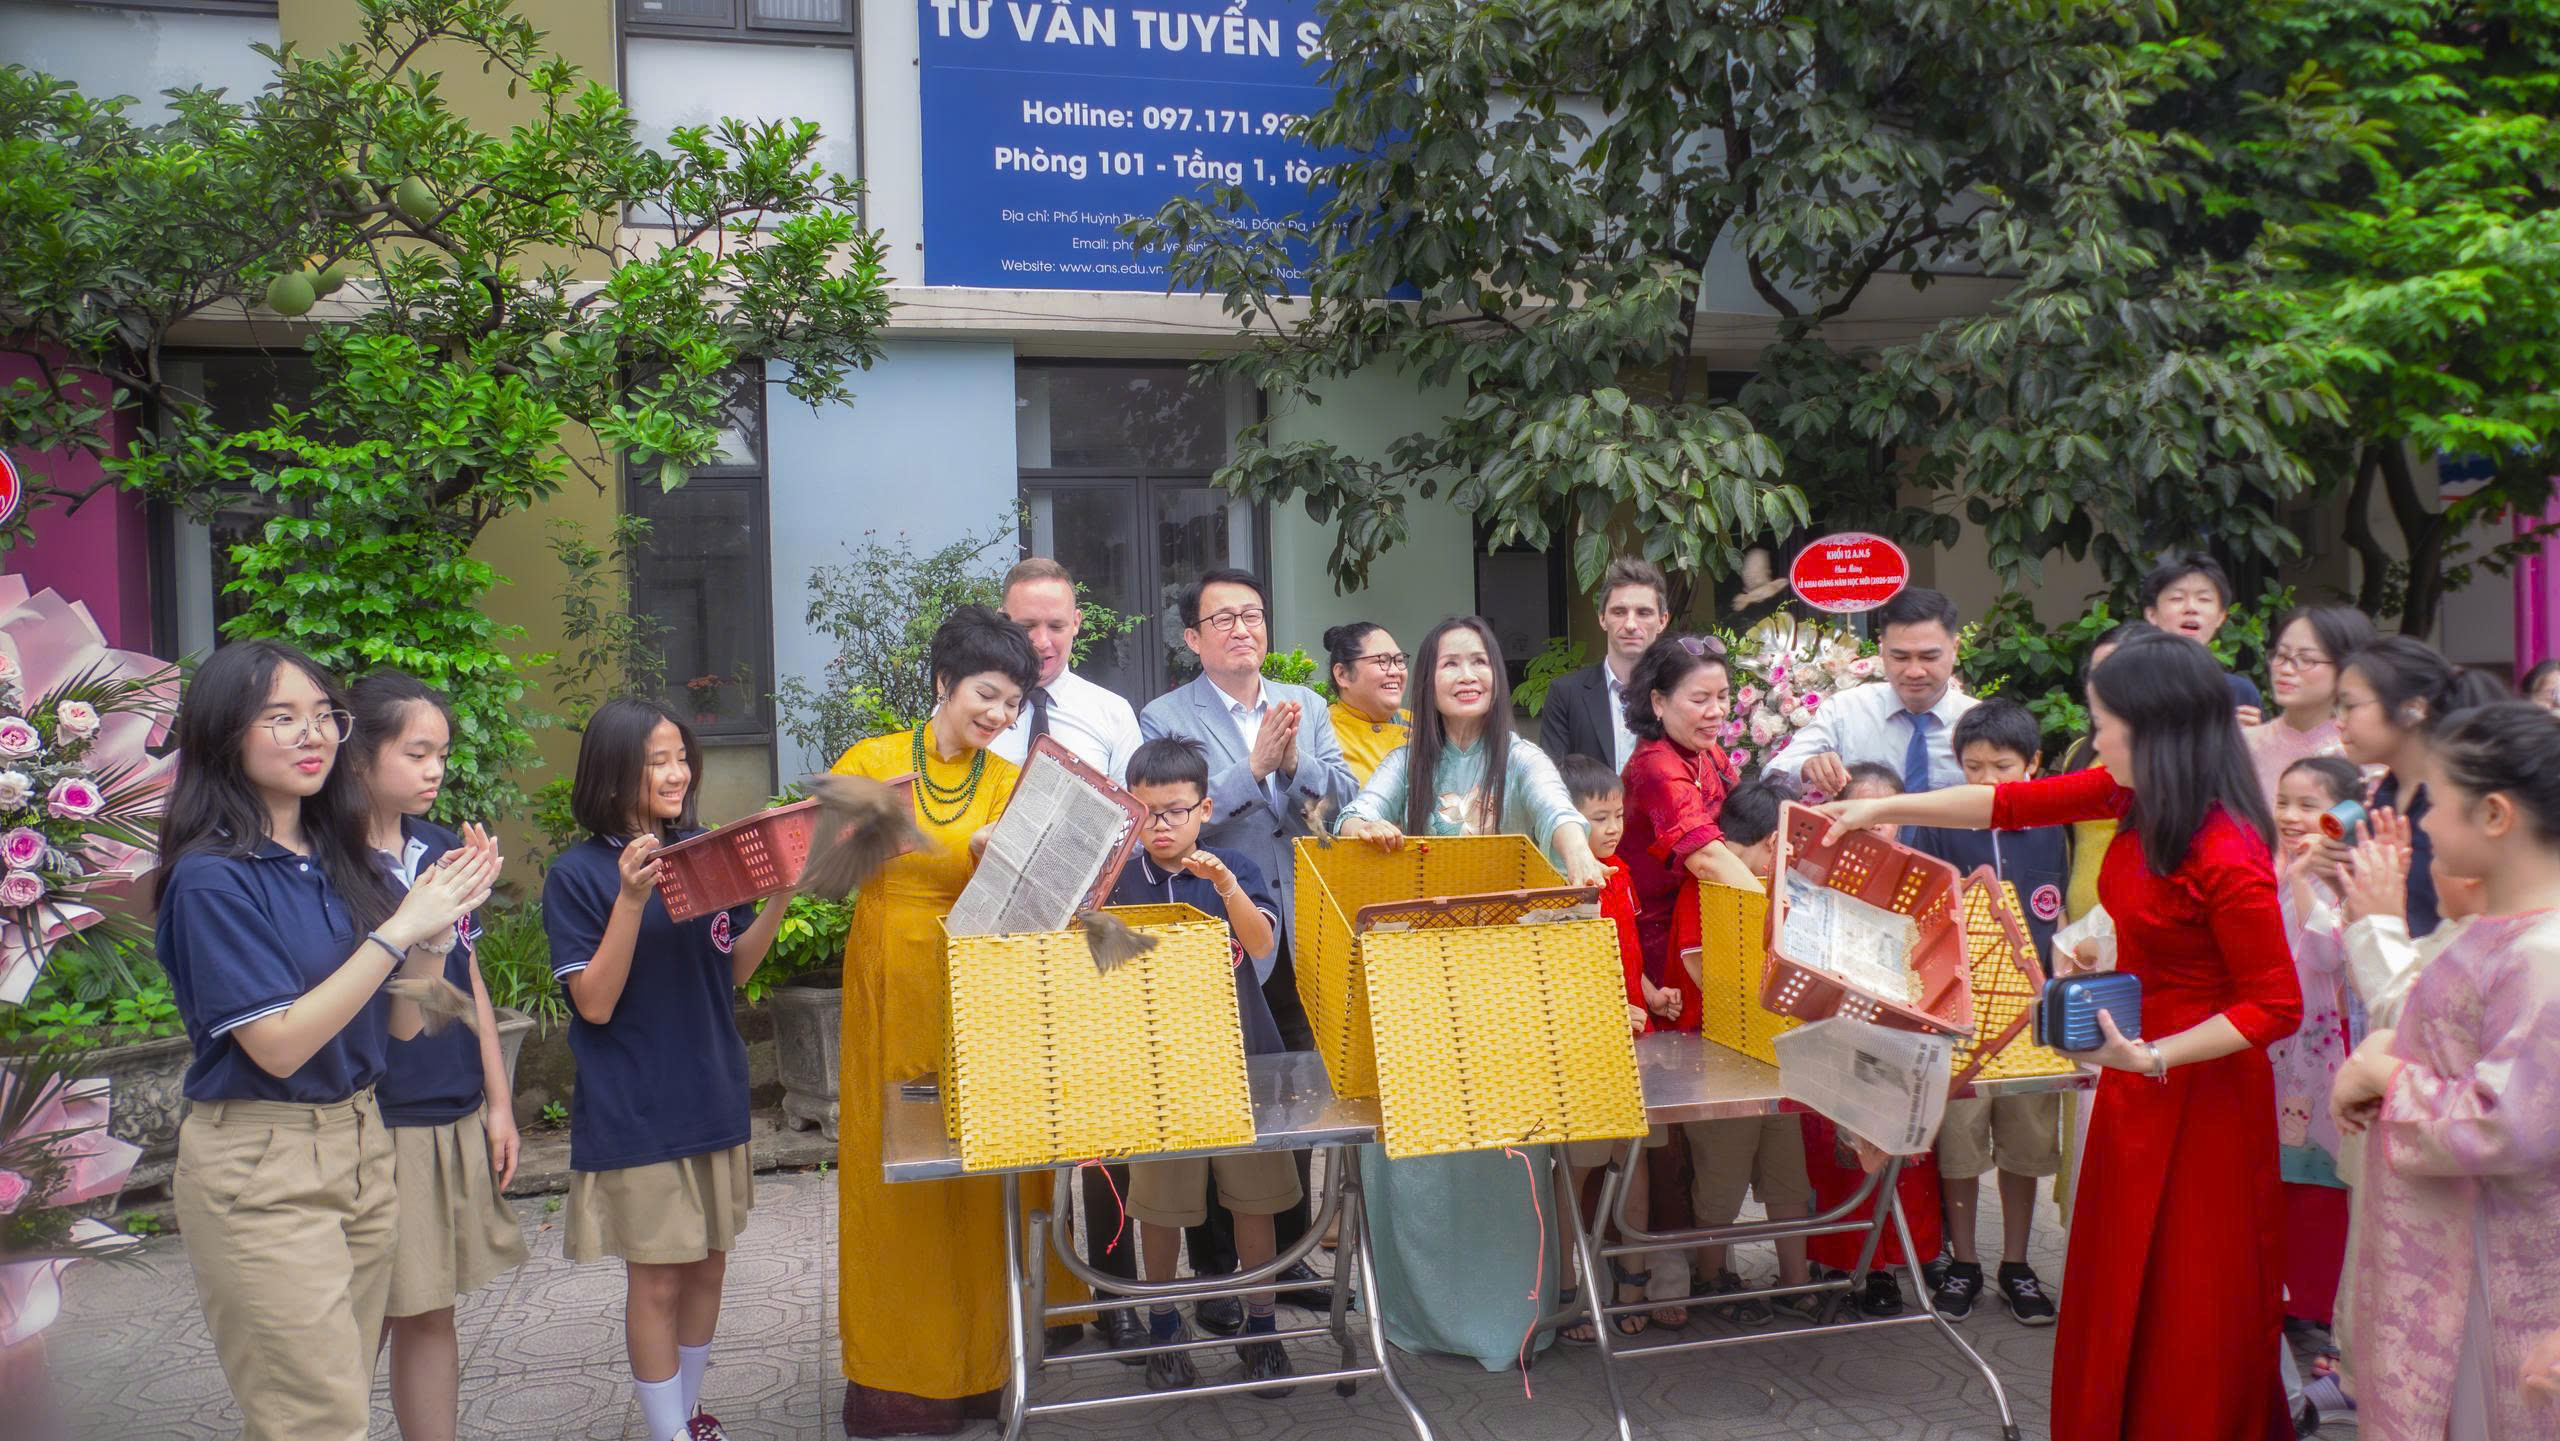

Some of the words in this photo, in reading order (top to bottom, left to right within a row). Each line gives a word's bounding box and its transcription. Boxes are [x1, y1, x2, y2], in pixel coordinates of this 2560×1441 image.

[1132, 0, 1281, 57] TUYỂN
[1023, 99, 1133, 129] Hotline:
[995, 147, 1088, 180] Phòng
[1098, 151, 1144, 175] 101
[1156, 163, 1167, 171] -
[1172, 148, 1243, 186] Tầng
[1253, 158, 1277, 186] 1,
[1002, 209, 1024, 225] Địa
[1027, 210, 1050, 223] chỉ:
[1053, 210, 1078, 224] Phố
[1081, 211, 1121, 227] Huỳnh
[1072, 237, 1109, 250] Email:
[1001, 259, 1056, 273] Website:
